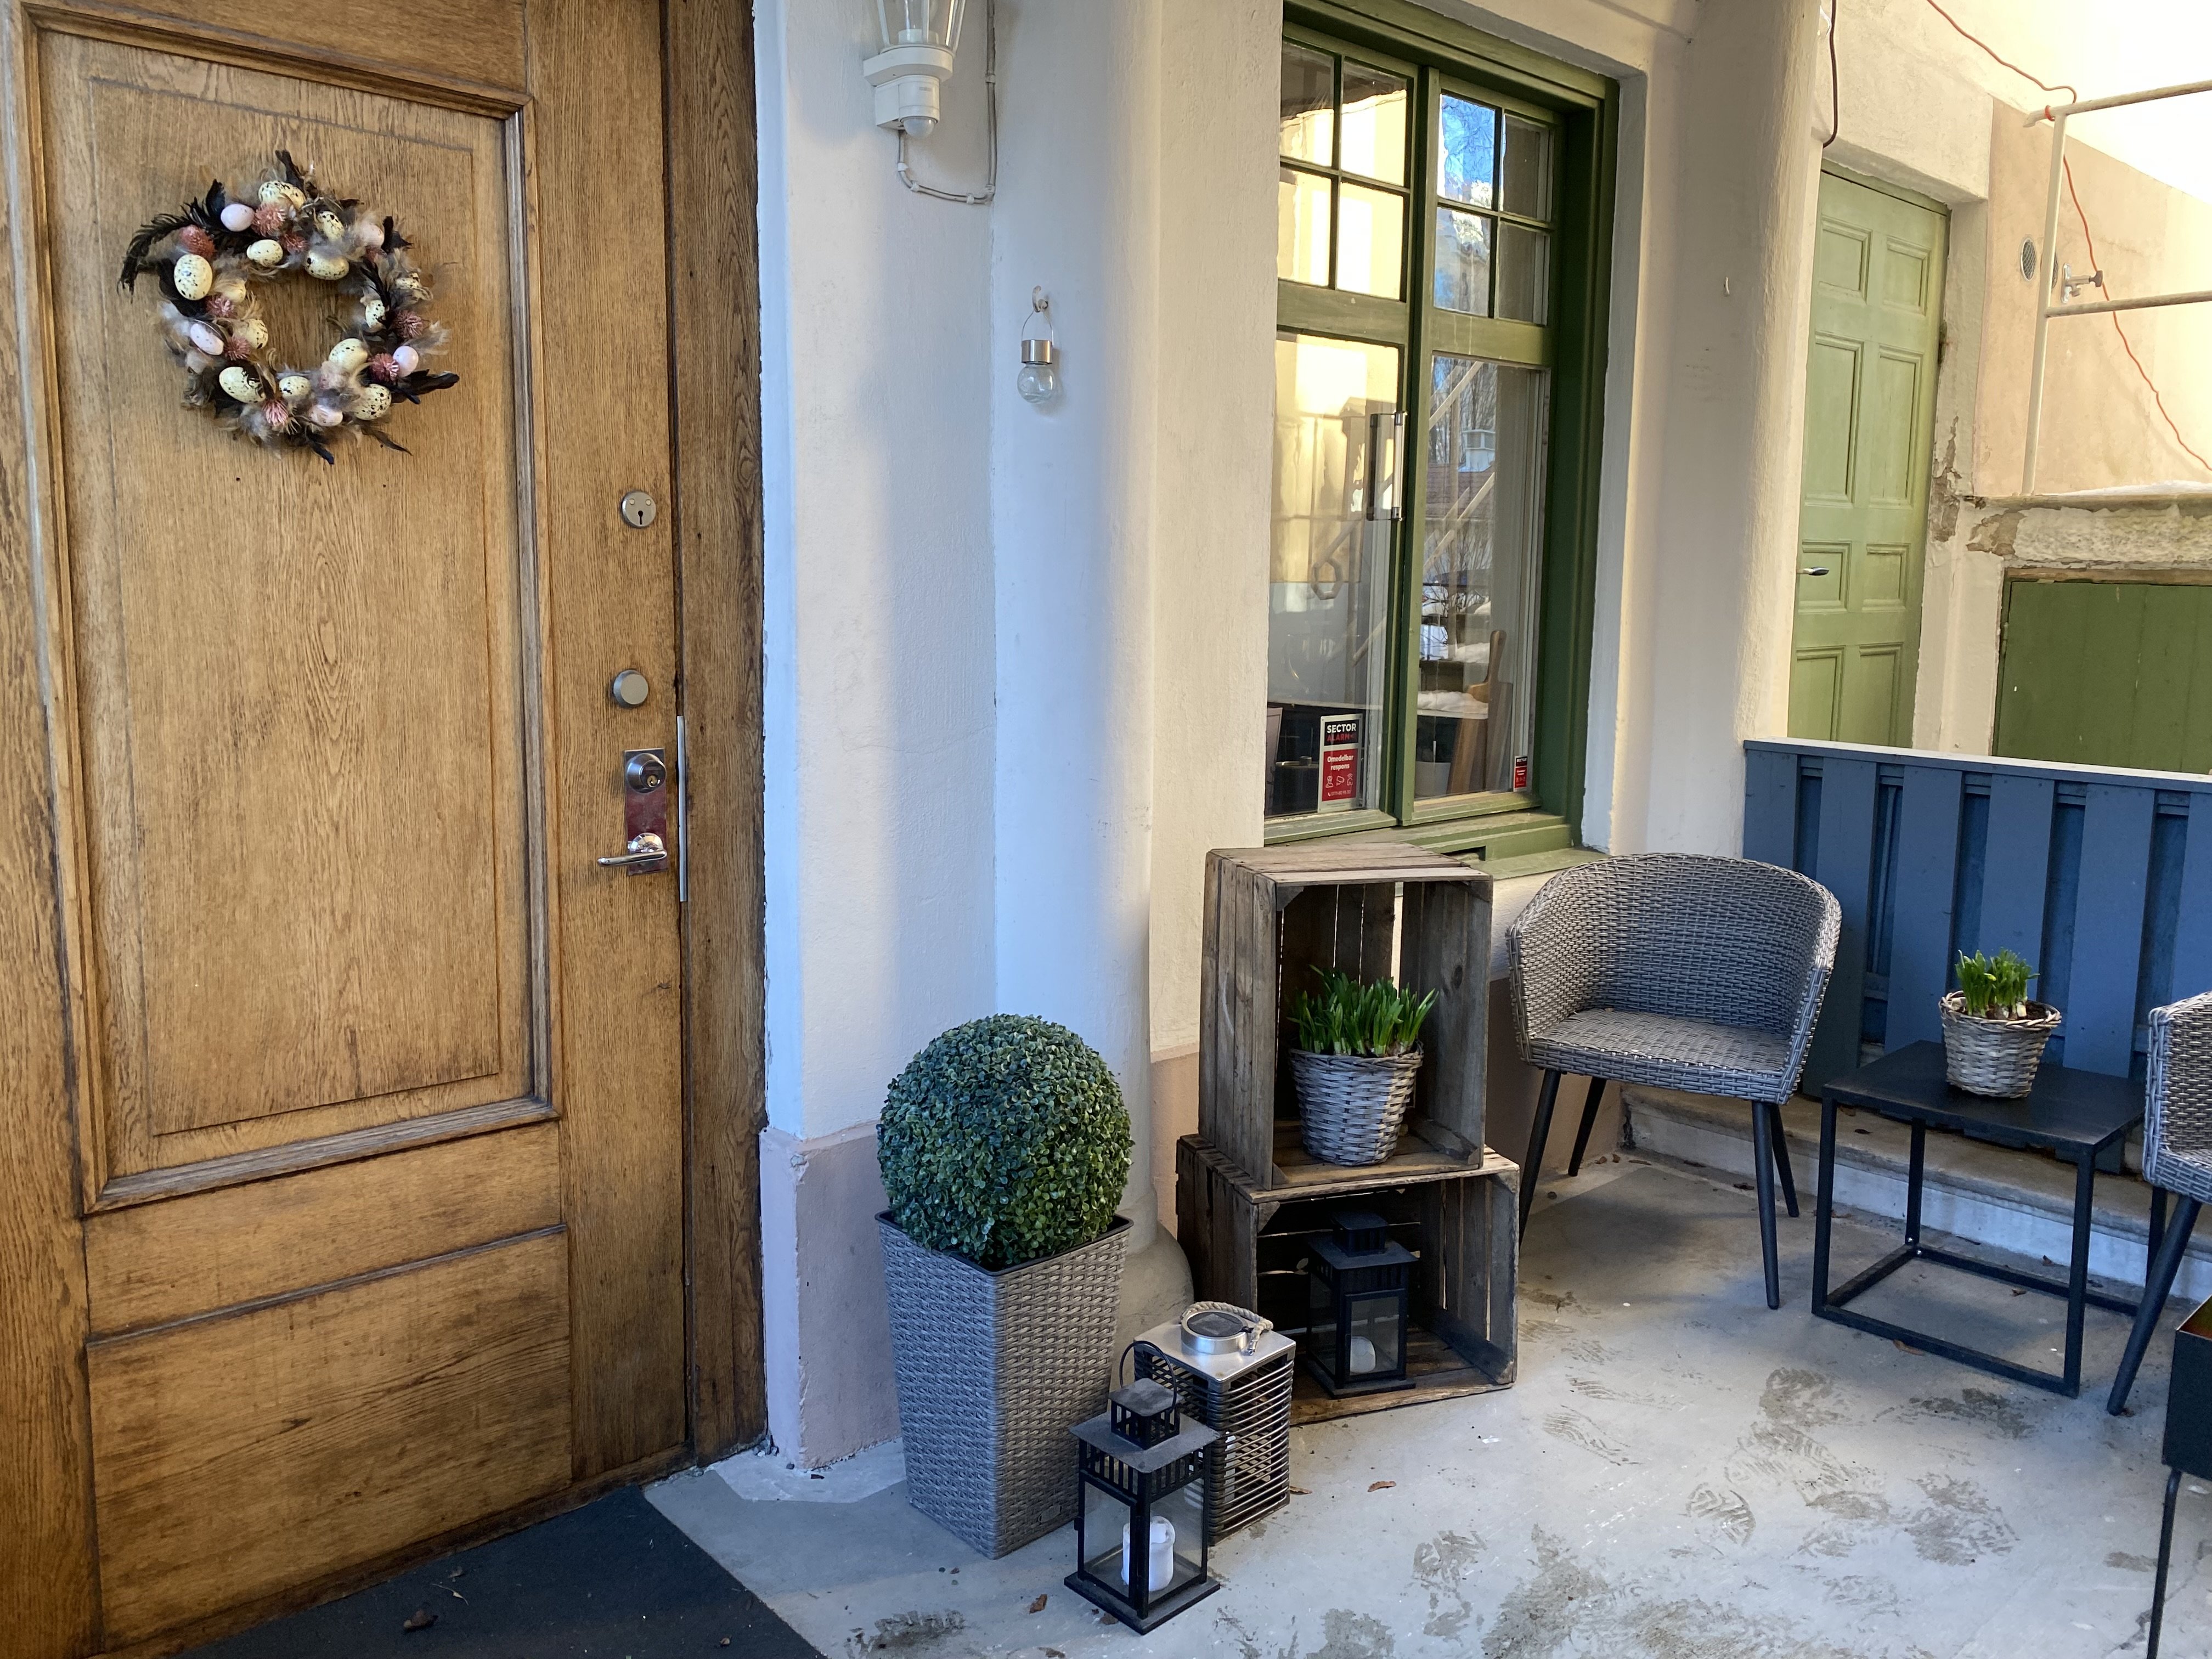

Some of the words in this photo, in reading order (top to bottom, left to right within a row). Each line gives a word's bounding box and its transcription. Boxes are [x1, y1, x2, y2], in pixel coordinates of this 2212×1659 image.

[1327, 723, 1356, 733] SECTOR
[1327, 733, 1350, 742] ALARM
[1327, 754, 1353, 763] Omedelbar
